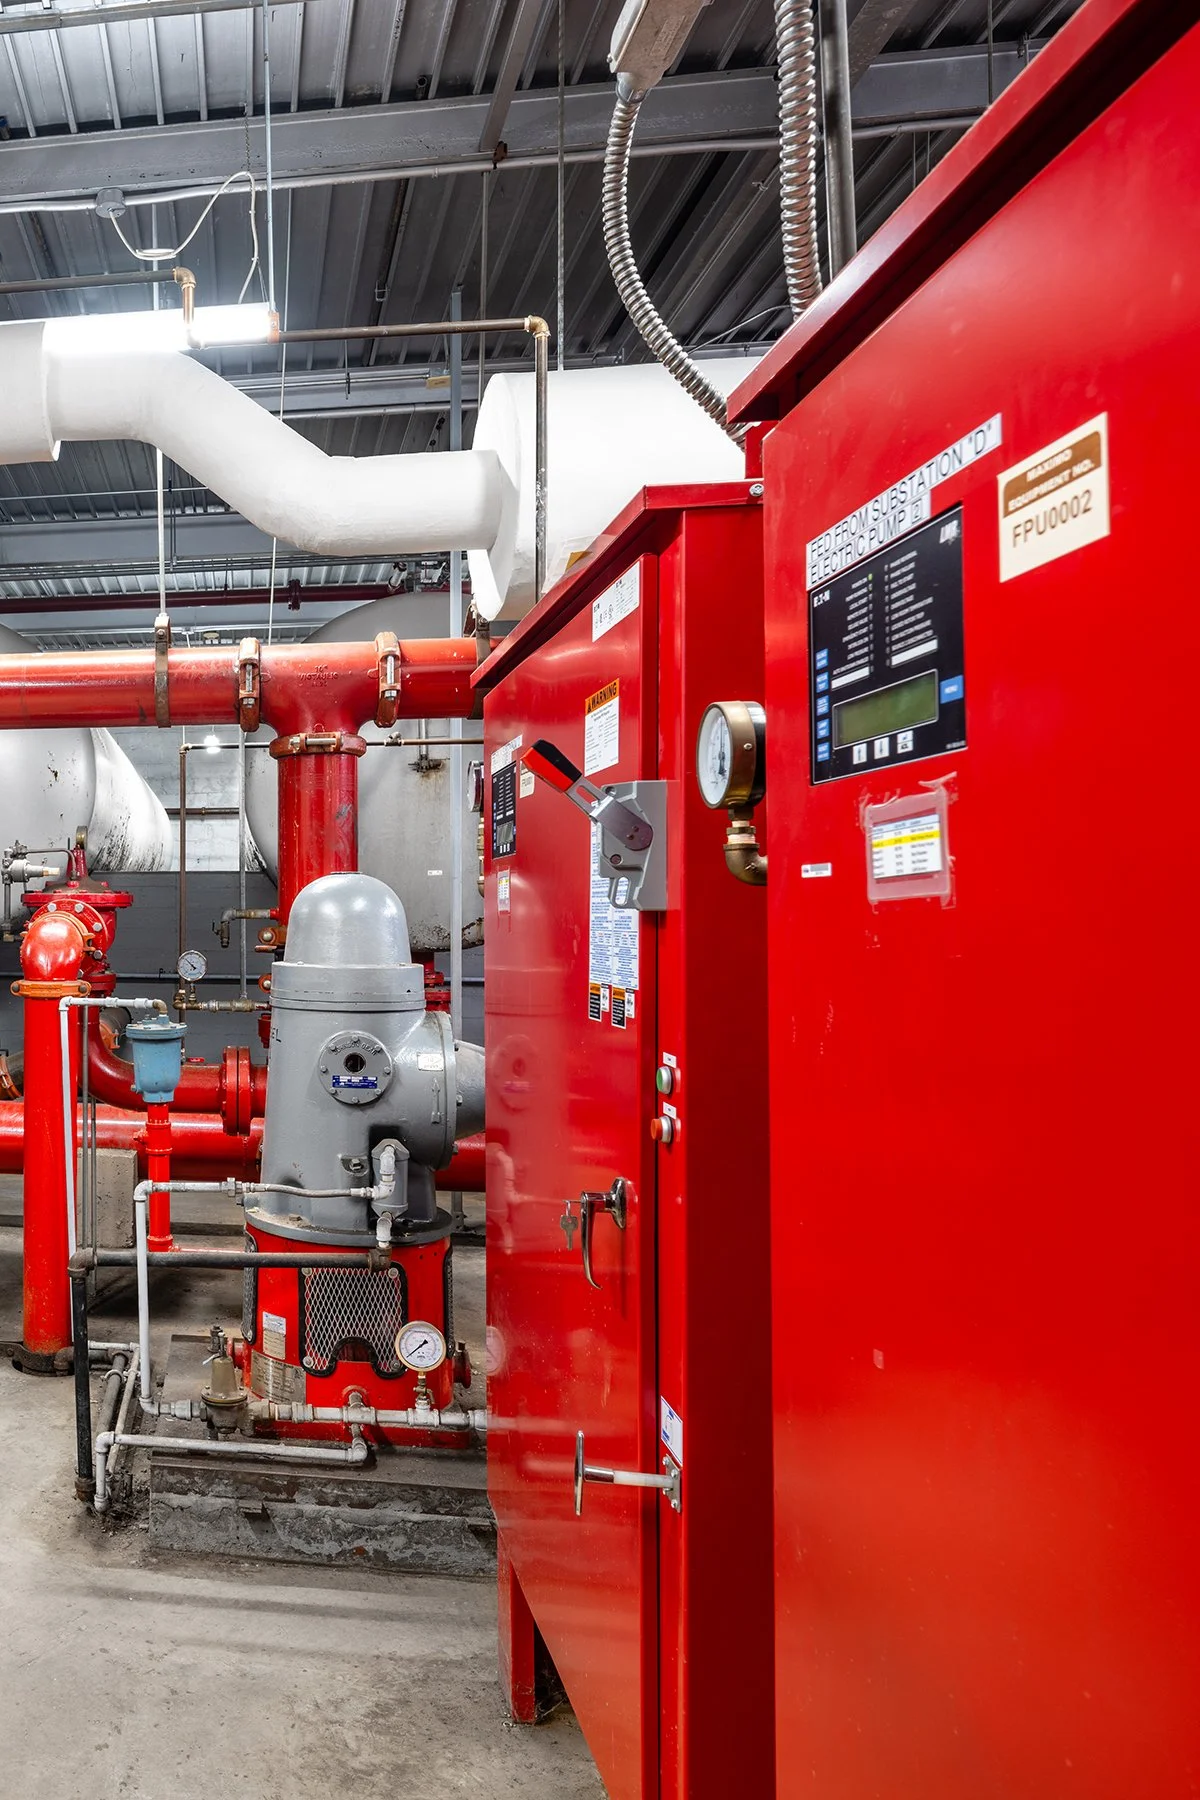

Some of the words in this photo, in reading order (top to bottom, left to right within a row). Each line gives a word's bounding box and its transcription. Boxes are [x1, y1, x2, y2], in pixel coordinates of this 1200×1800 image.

[811, 531, 831, 560] FED
[834, 506, 868, 545] FROM
[873, 447, 962, 521] SUBSTATION
[1008, 469, 1071, 511] EQUIPMENT
[1012, 489, 1092, 548] FPU0002
[811, 535, 865, 585] ELECTRIC
[869, 509, 906, 549] PUMP
[591, 684, 617, 710] WARNING
